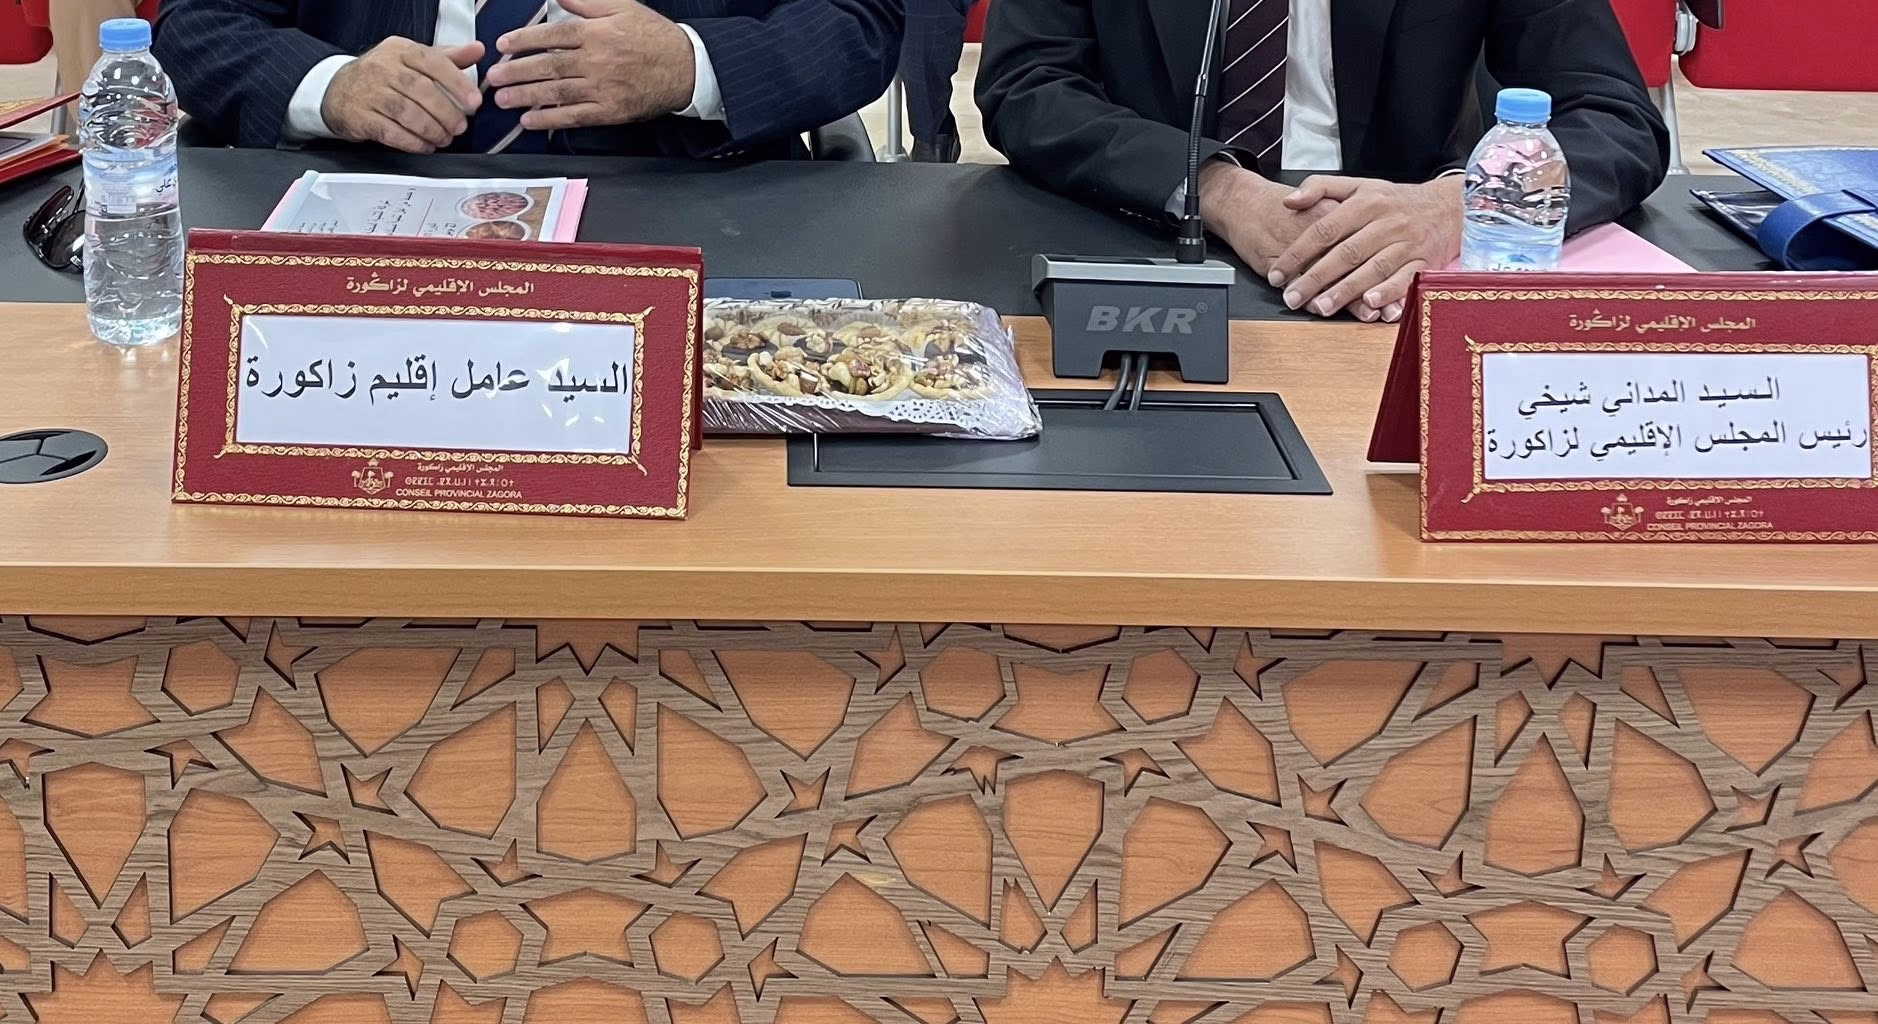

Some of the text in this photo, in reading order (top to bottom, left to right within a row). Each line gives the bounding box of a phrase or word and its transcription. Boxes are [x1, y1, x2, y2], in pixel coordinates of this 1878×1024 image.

[478, 281, 534, 297] المجلس
[1086, 305, 1198, 335] BKR
[1700, 317, 1756, 333] المجلس
[246, 354, 628, 405] السيد عامل إقليم زاكورة
[1518, 377, 1779, 420] السيد المداني شيخي
[1488, 421, 1868, 462] رئيس المجلس الإقليمي لزاكورة
[396, 488, 522, 499] CONSEIL PROVINCIAL ZAGORA
